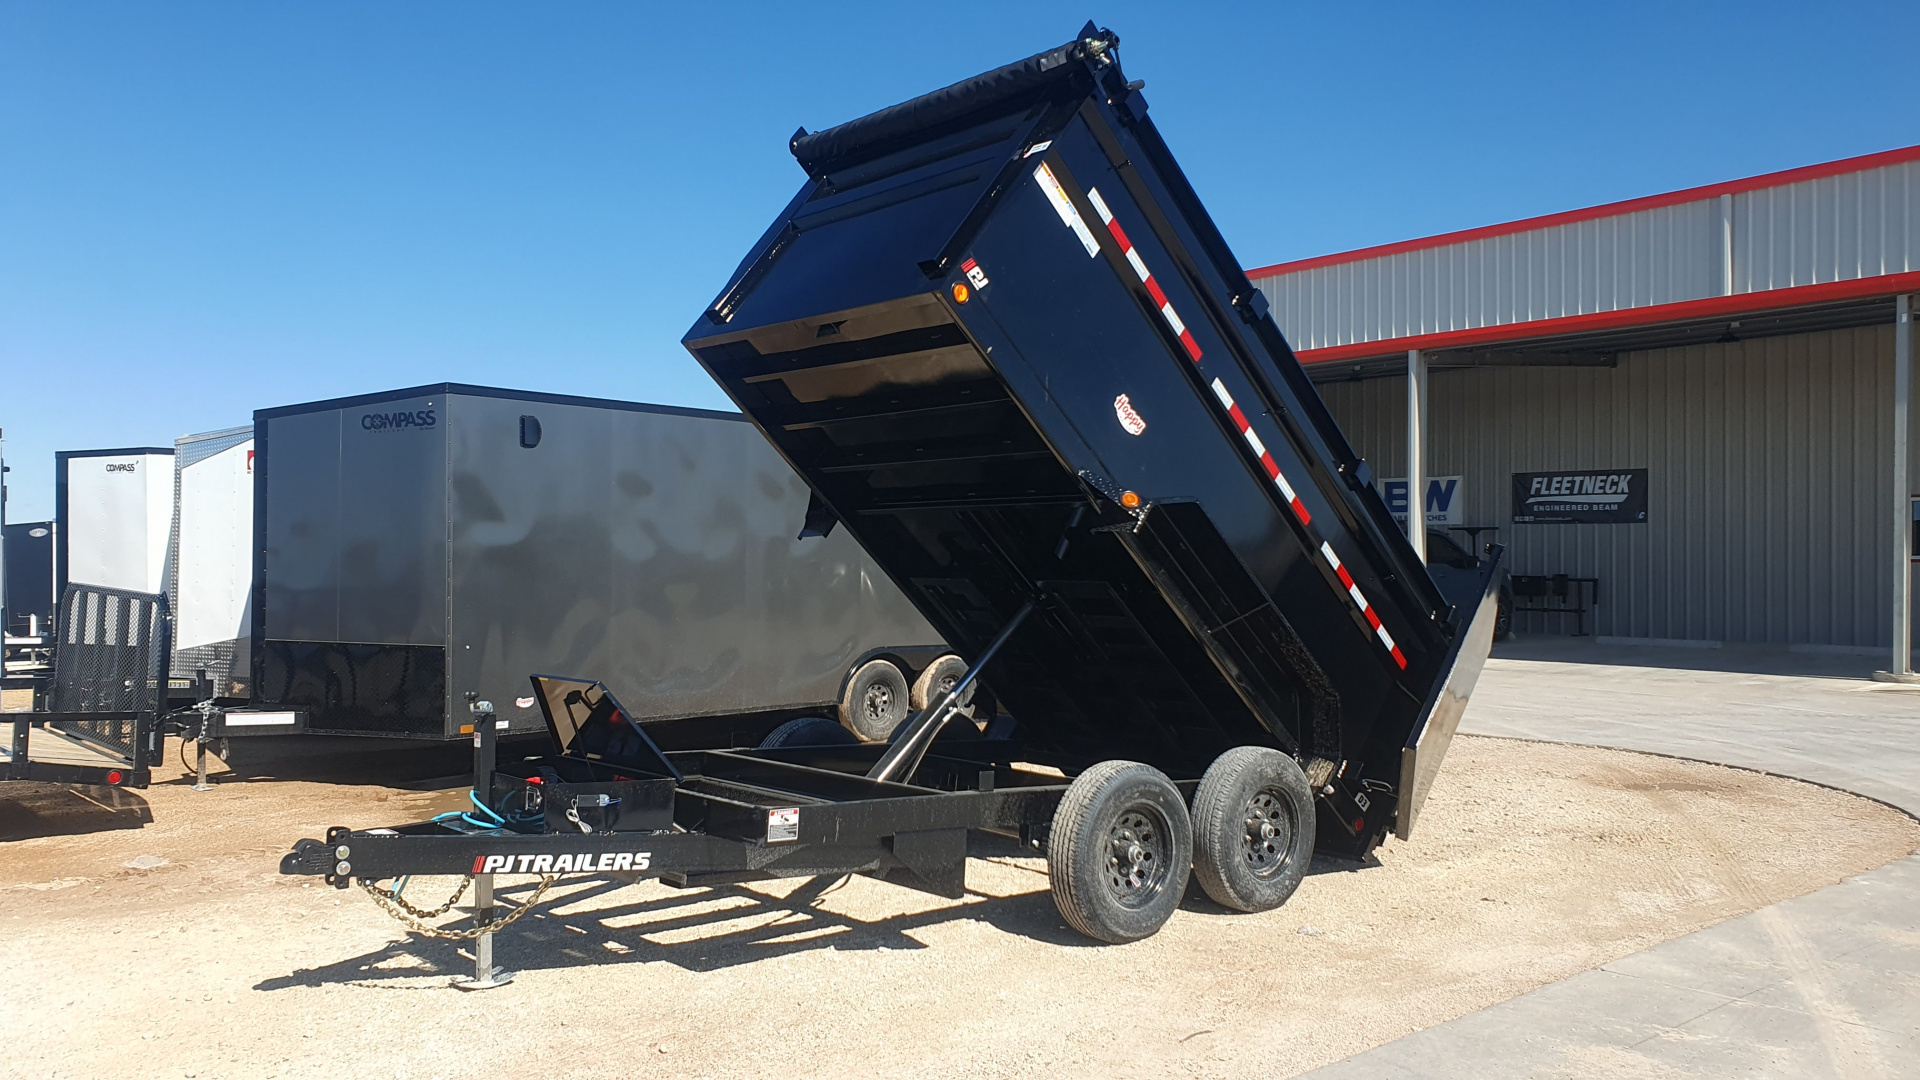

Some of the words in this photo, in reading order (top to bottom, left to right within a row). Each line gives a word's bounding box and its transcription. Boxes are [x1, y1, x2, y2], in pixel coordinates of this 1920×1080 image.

[361, 410, 436, 430] COMPASS
[1116, 396, 1144, 434] Happy
[105, 464, 135, 472] COMPASS
[1530, 475, 1632, 495] FLEETNECK
[483, 855, 515, 873] PJ
[518, 852, 651, 873] TRAILERS
